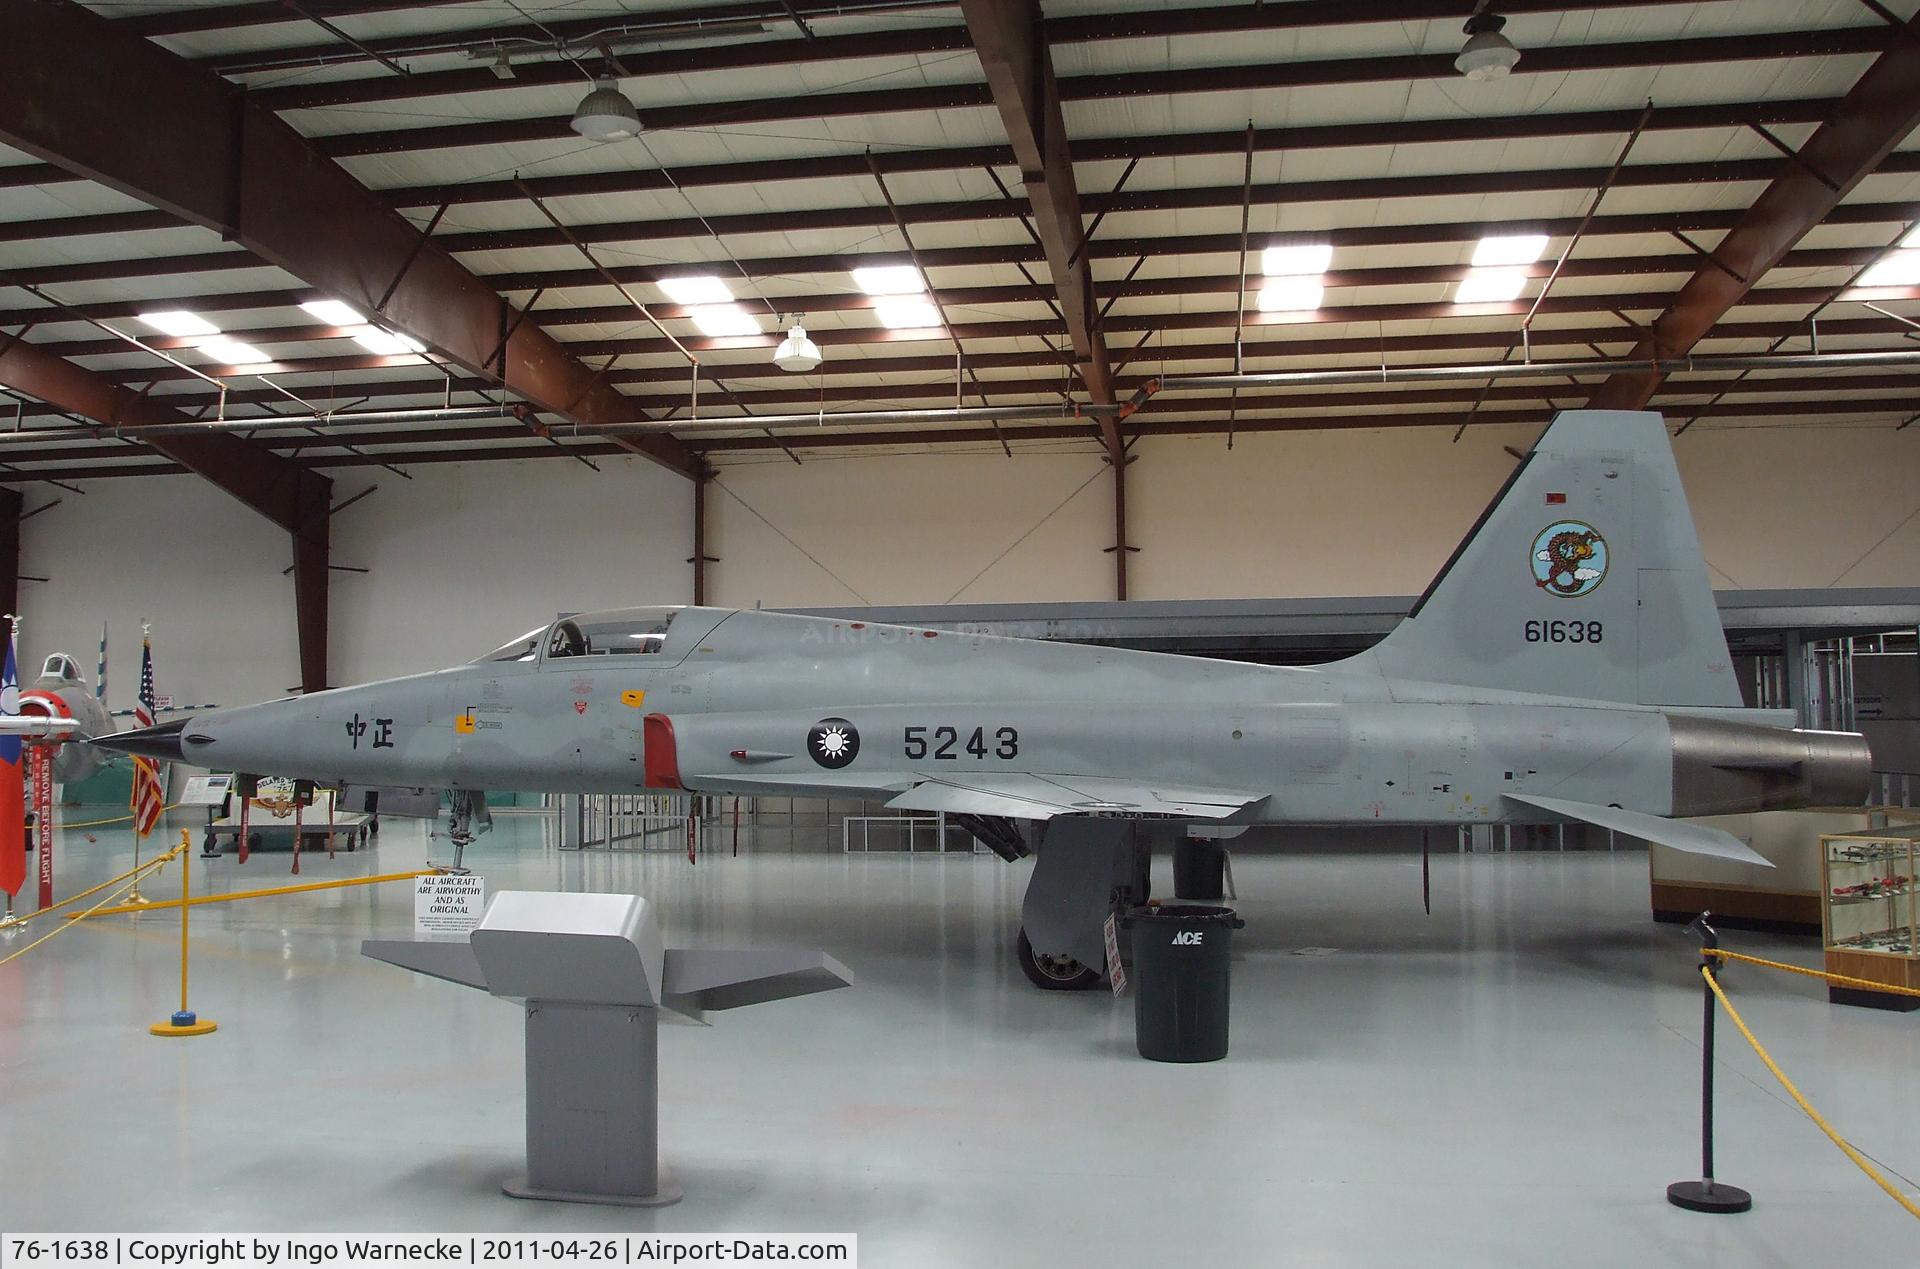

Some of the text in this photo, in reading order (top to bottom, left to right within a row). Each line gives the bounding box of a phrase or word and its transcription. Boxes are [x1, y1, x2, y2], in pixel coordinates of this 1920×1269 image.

[1525, 620, 1603, 644] 61638
[345, 713, 394, 750] 中正
[904, 726, 1018, 759] 5243
[41, 759, 50, 885] REMOVE BEFORE FLIGHT
[438, 877, 476, 886] AIRCRAFT
[417, 886, 482, 895] ARE AIRWORTHY
[434, 896, 465, 904] AND AS
[430, 905, 469, 914] ORIGINAL
[1171, 930, 1203, 945] ACE
